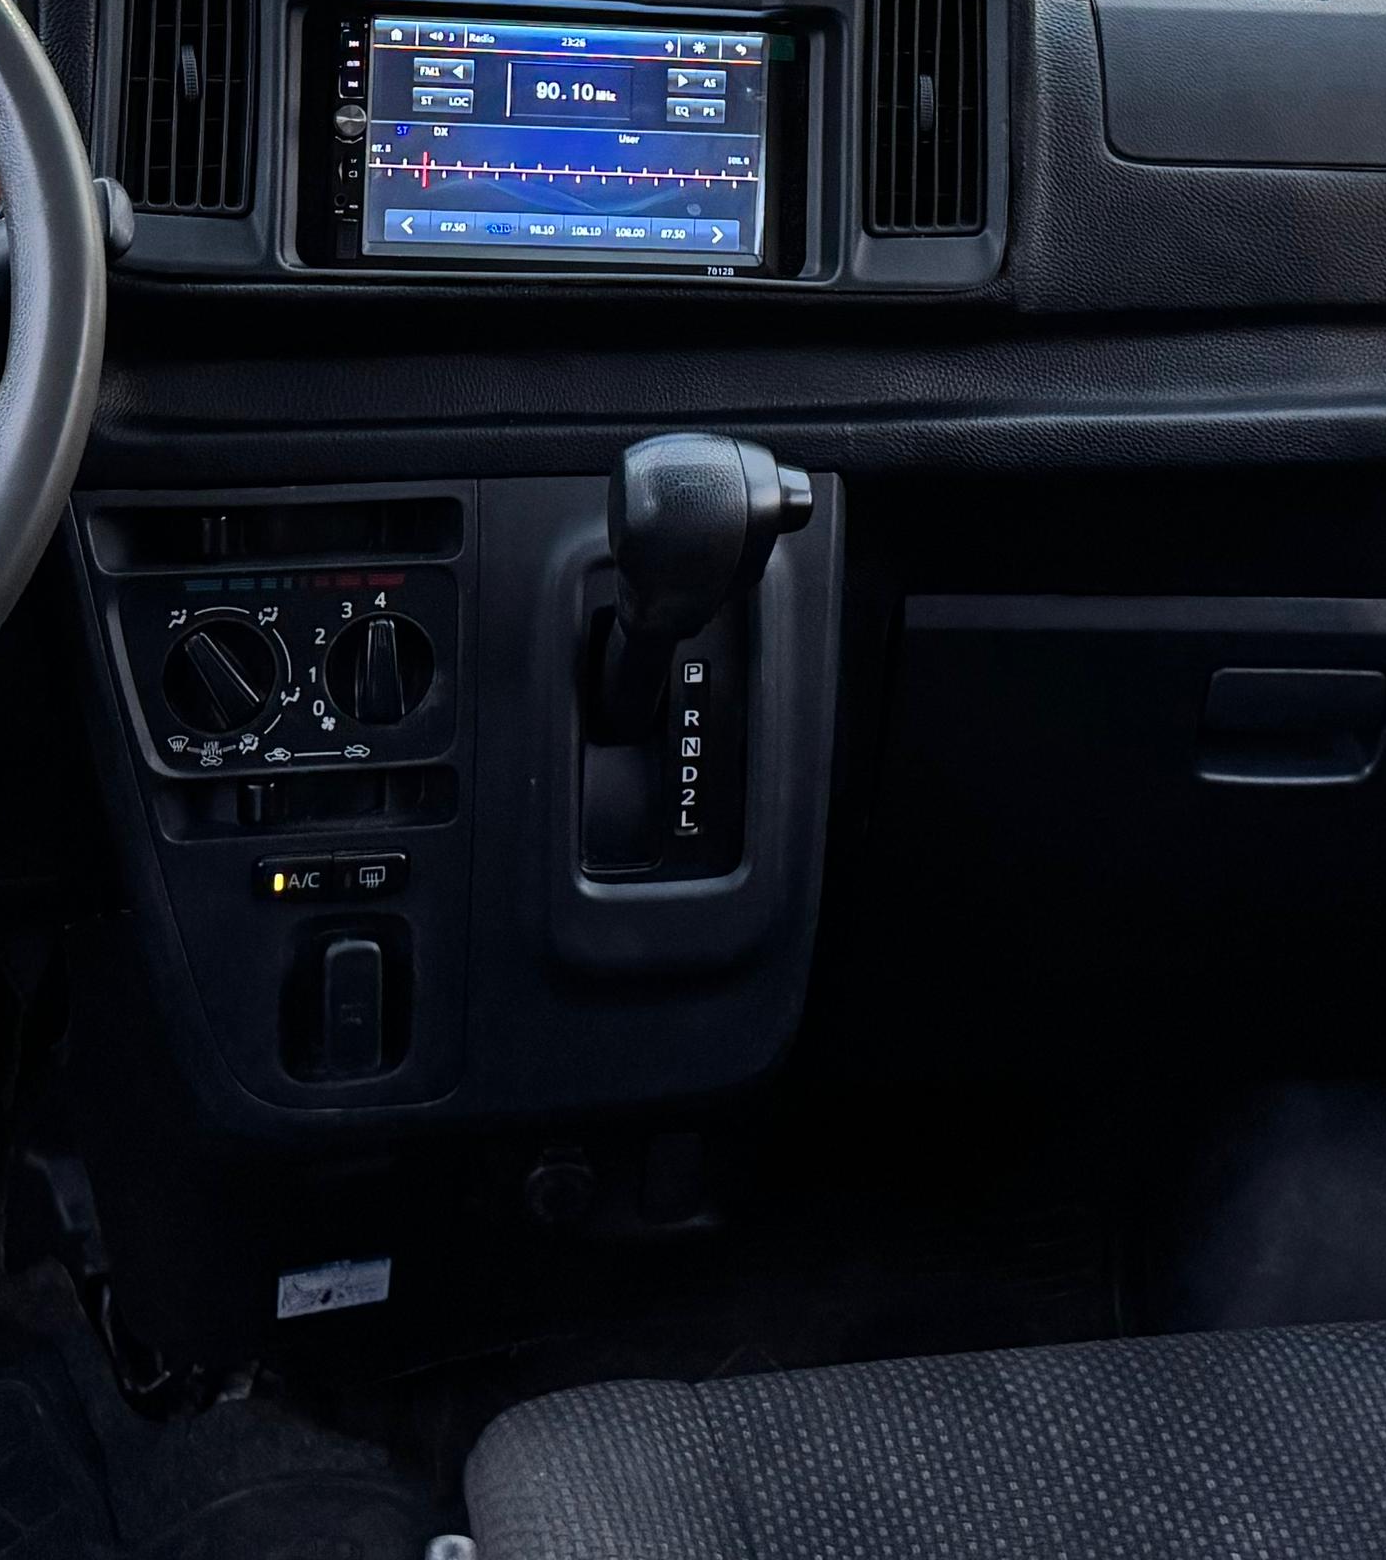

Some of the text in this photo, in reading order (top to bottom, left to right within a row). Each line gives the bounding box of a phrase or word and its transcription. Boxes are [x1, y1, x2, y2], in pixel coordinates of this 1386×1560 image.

[468, 33, 495, 44] Radio
[419, 66, 441, 77] FM1
[536, 81, 617, 102] 90.10 MHz
[703, 77, 717, 89] AS
[420, 95, 470, 108] ST LOC
[674, 105, 690, 118] EQ
[396, 125, 449, 137] ST DX
[618, 134, 641, 145] User
[374, 591, 387, 608] 4
[341, 601, 353, 618] 3
[314, 627, 326, 644] 2
[308, 666, 317, 683] 1
[686, 665, 702, 682] P
[312, 699, 325, 716] 0
[684, 709, 700, 727] R
[683, 738, 700, 756] N
[682, 766, 698, 783] D
[681, 788, 696, 806] 2
[681, 810, 695, 827] L
[287, 871, 321, 889] A/C
